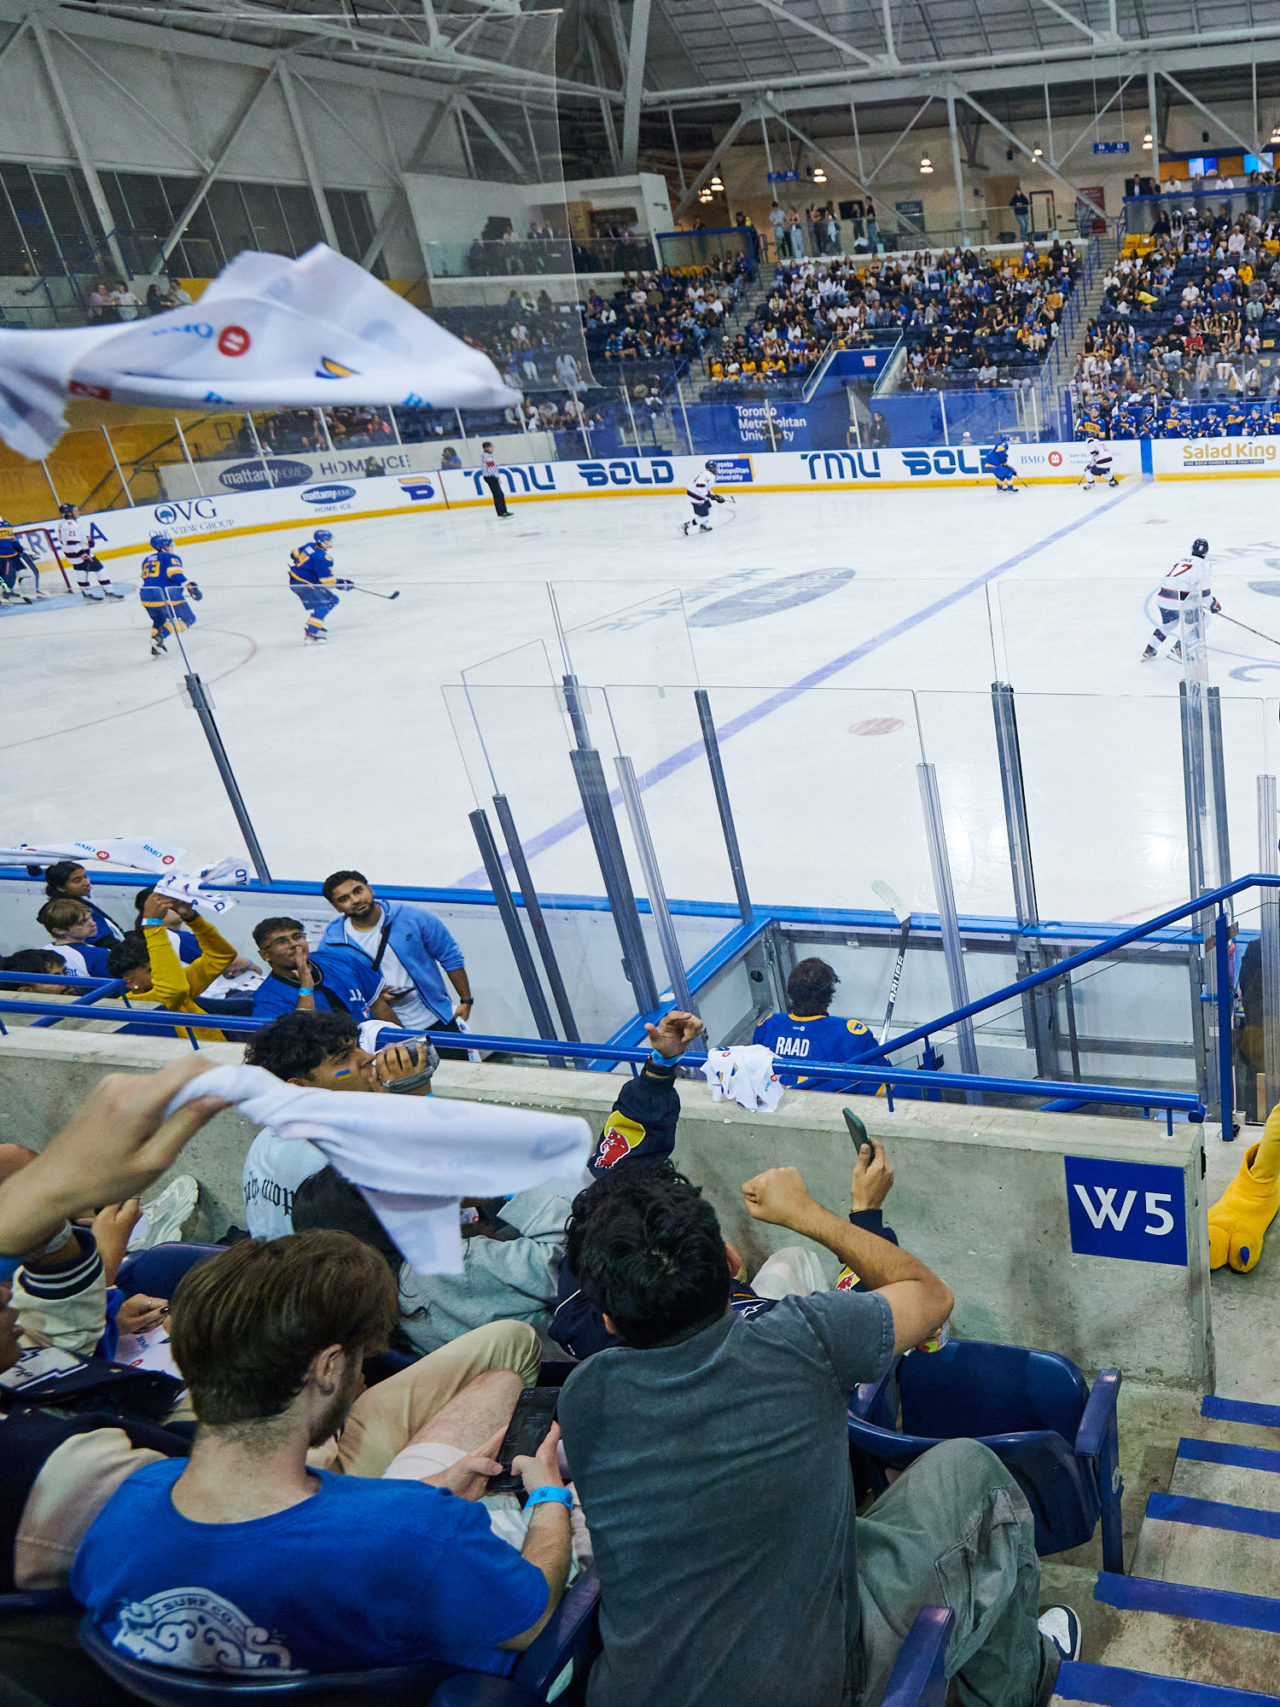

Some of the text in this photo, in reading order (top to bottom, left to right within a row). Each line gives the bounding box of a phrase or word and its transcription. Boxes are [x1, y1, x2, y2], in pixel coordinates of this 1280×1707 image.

[1020, 455, 1045, 464] BMO
[1183, 442, 1276, 461] Salad King
[577, 459, 675, 487] BOLD
[800, 451, 881, 481] TMU
[463, 464, 556, 496] TMU
[154, 498, 218, 525] OVG
[142, 561, 160, 579] 63
[1165, 562, 1193, 577] 17
[143, 843, 163, 858] BMO
[775, 1036, 810, 1058] RAAD
